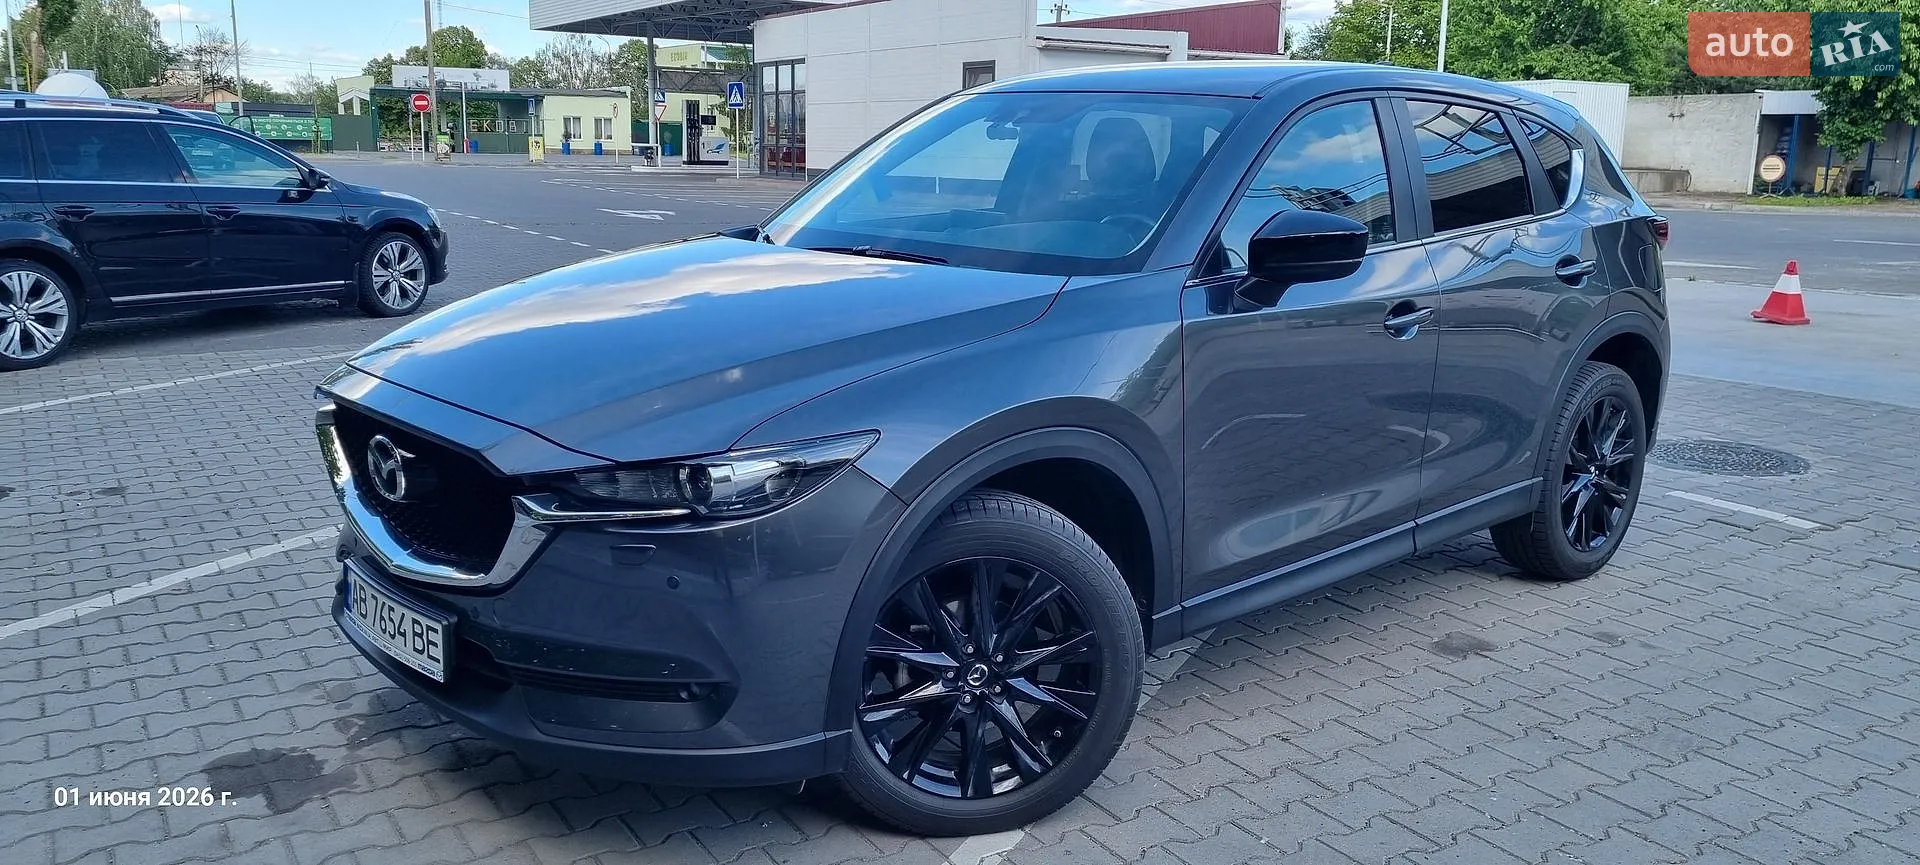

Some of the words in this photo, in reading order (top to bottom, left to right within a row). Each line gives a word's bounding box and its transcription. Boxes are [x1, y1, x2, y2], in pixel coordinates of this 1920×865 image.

[352, 579, 368, 620] AB
[371, 593, 407, 648] 7654
[411, 616, 441, 664] BE
